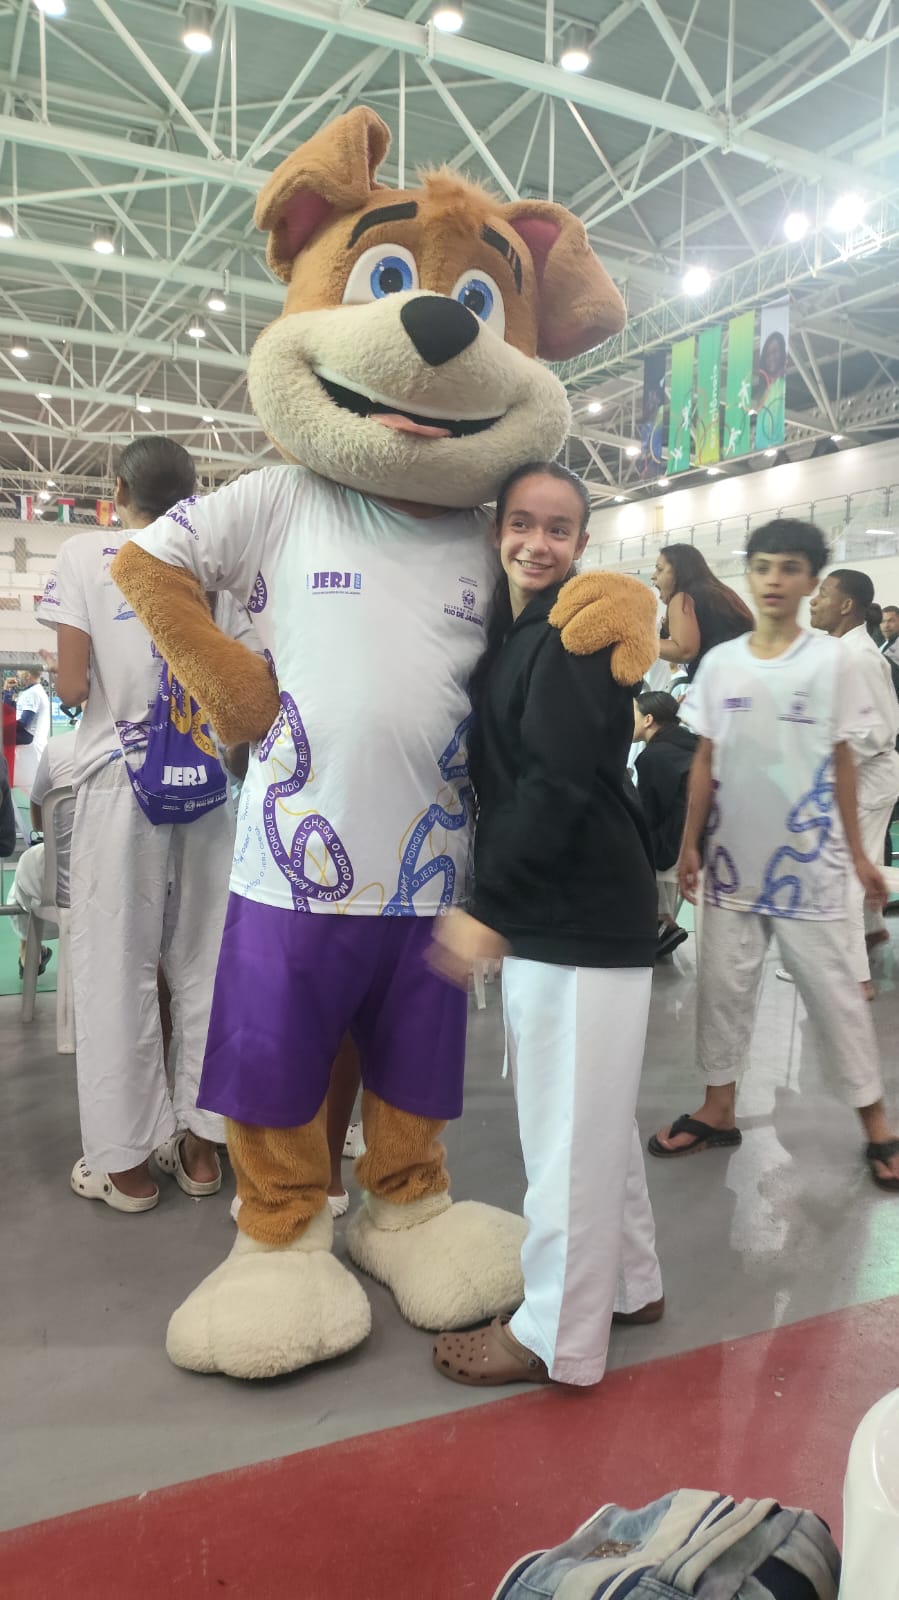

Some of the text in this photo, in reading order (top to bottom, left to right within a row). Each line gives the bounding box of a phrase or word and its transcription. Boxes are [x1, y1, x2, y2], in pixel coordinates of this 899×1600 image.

[312, 572, 351, 589] JERJ
[297, 741, 308, 767] JERJ
[161, 765, 208, 786] JERJ
[265, 780, 300, 807] QUANDO
[266, 814, 281, 856] PORQUE
[295, 832, 307, 857] JERJ
[332, 843, 340, 851] O
[406, 824, 427, 865] PORQUE
[335, 853, 351, 880] JOGO
[412, 880, 420, 888] O
[420, 863, 439, 881] JERJ
[317, 882, 349, 900] MUDA
